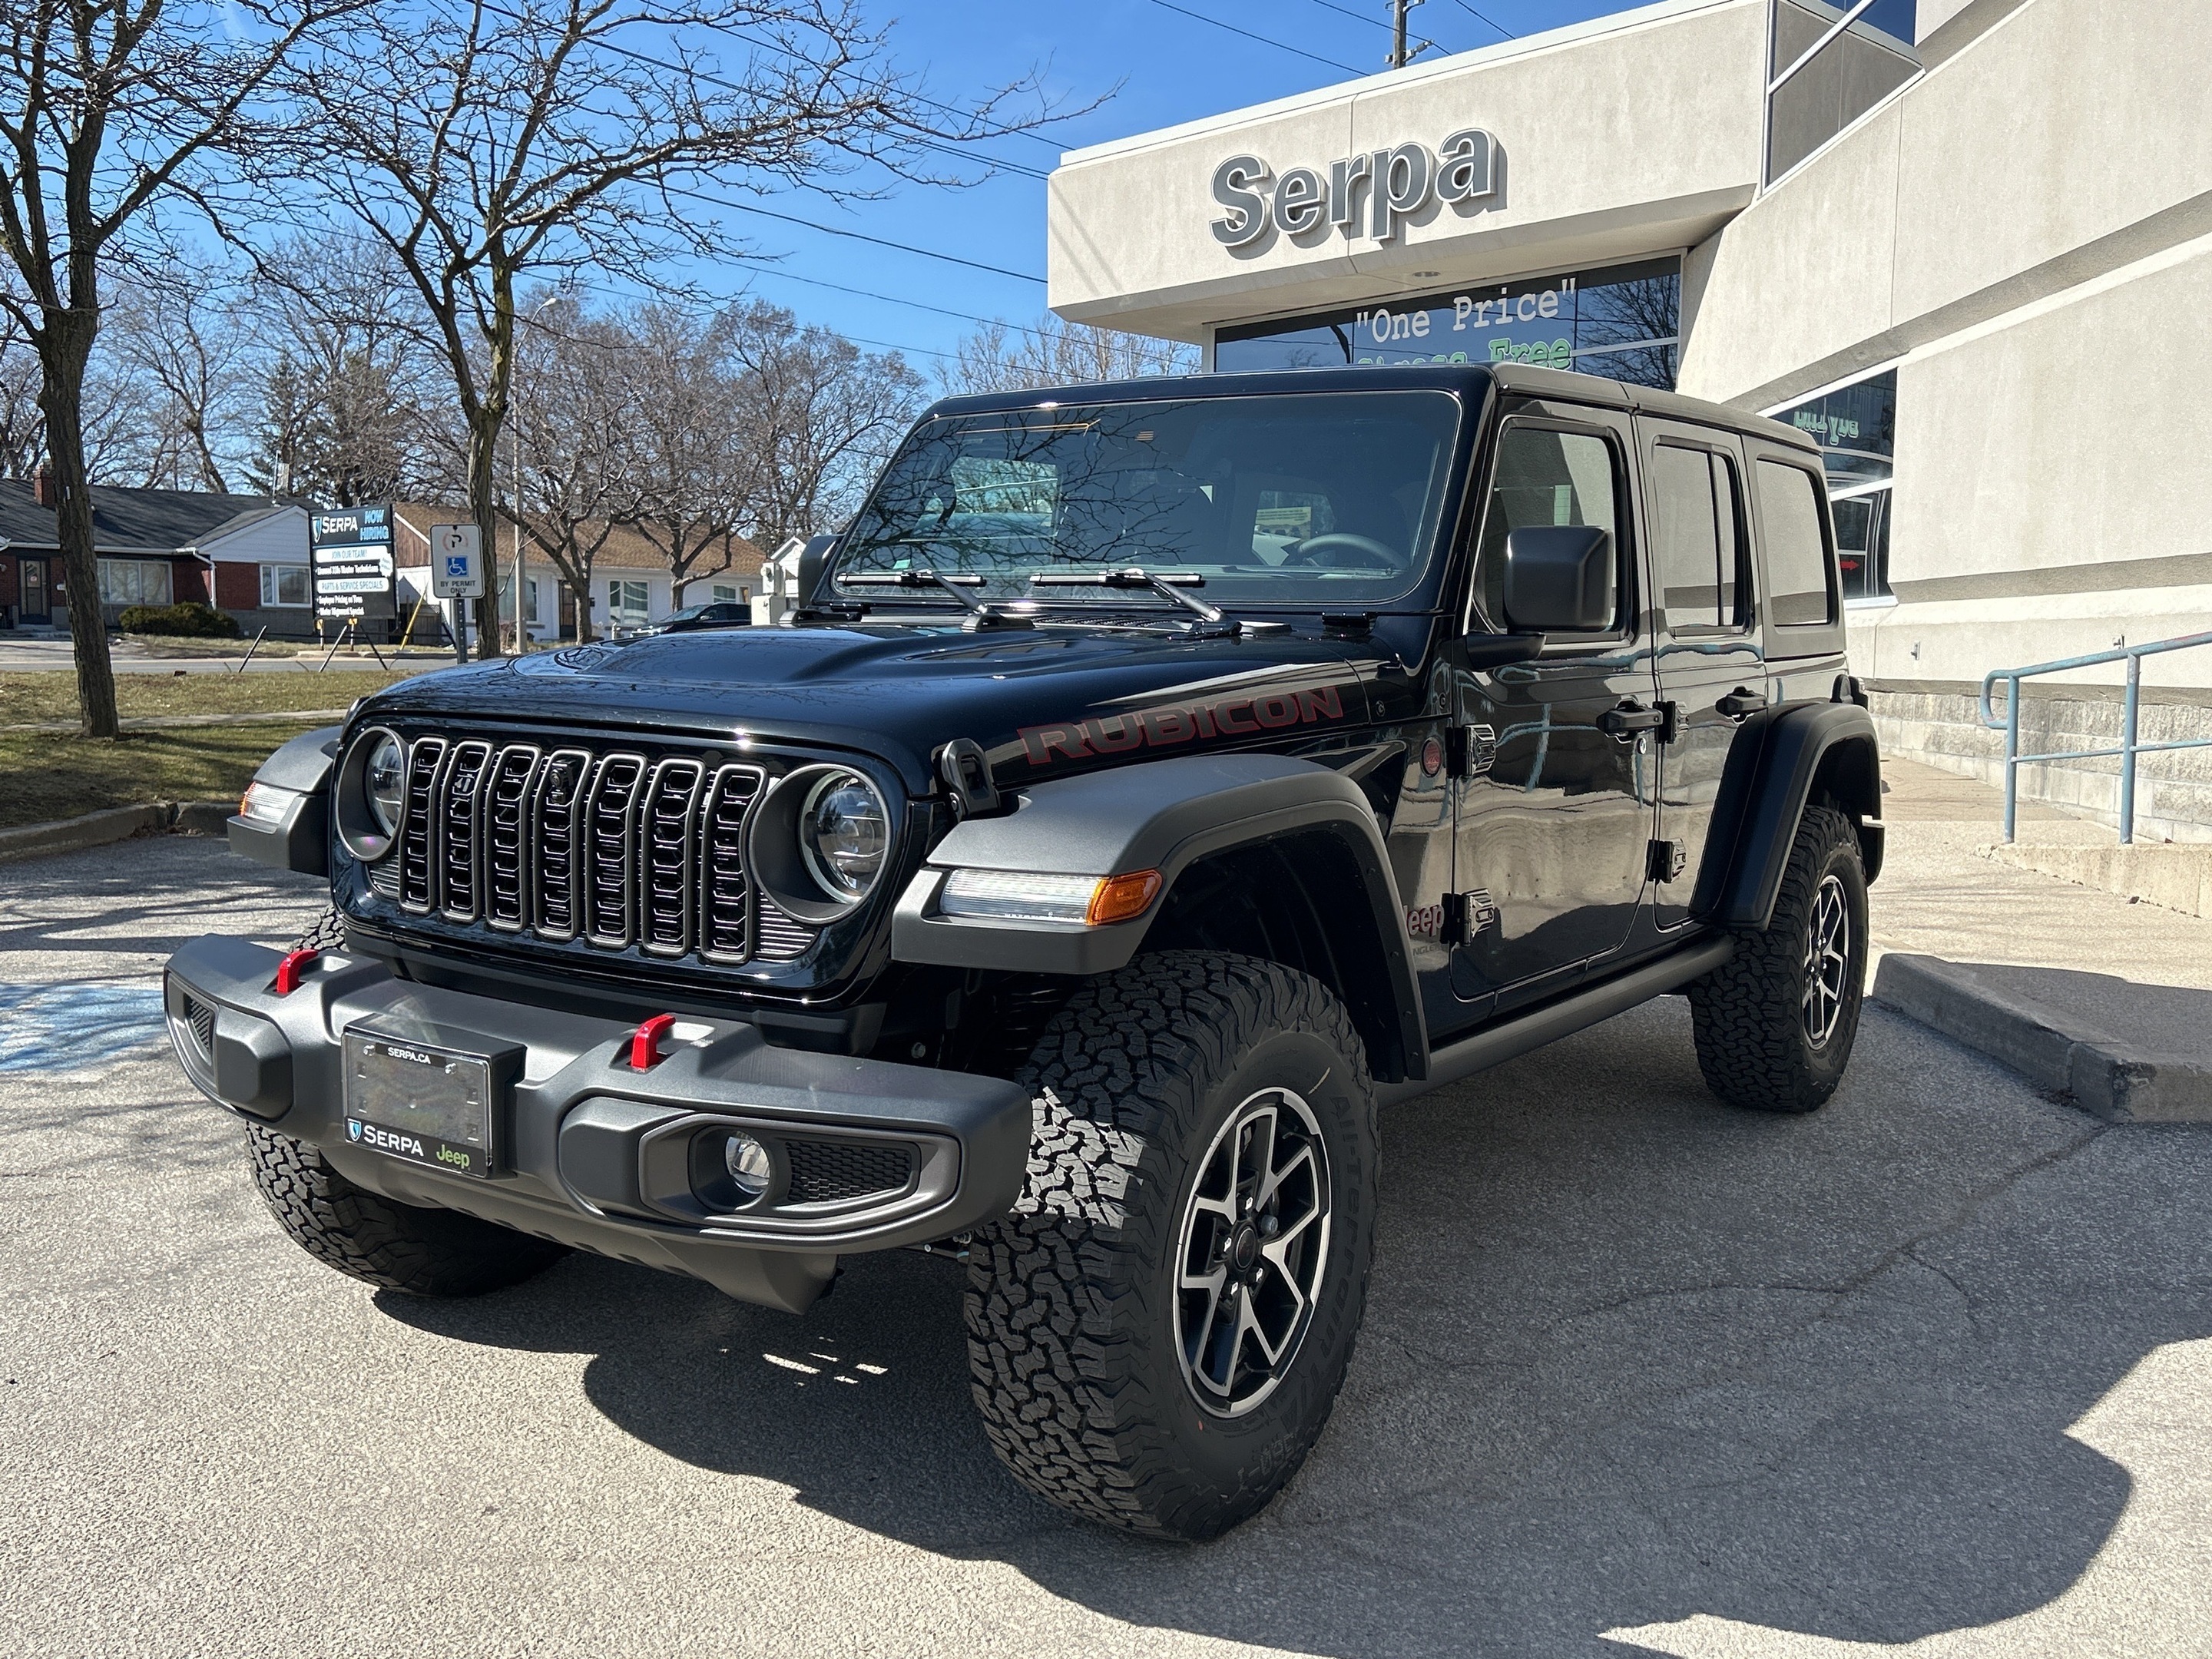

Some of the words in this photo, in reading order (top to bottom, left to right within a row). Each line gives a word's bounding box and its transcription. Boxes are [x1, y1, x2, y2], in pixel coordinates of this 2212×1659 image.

[1209, 127, 1498, 247] Serpa
[1356, 308, 1431, 343] "One
[1452, 277, 1577, 332] Price"
[1488, 337, 1573, 371] Free
[321, 515, 359, 535] SERPA
[364, 508, 385, 525] NOW
[359, 525, 389, 541] HIRING
[331, 550, 341, 560] JOIN
[342, 549, 352, 559] OUR
[322, 581, 336, 591] PARTS
[339, 581, 359, 591] SERVICE
[359, 580, 384, 590] SPECIALS
[1016, 686, 1345, 765] RUBICON
[387, 1047, 432, 1065] SERPA.CA
[363, 1124, 424, 1157] SERPA
[435, 1144, 470, 1170] Jeep
